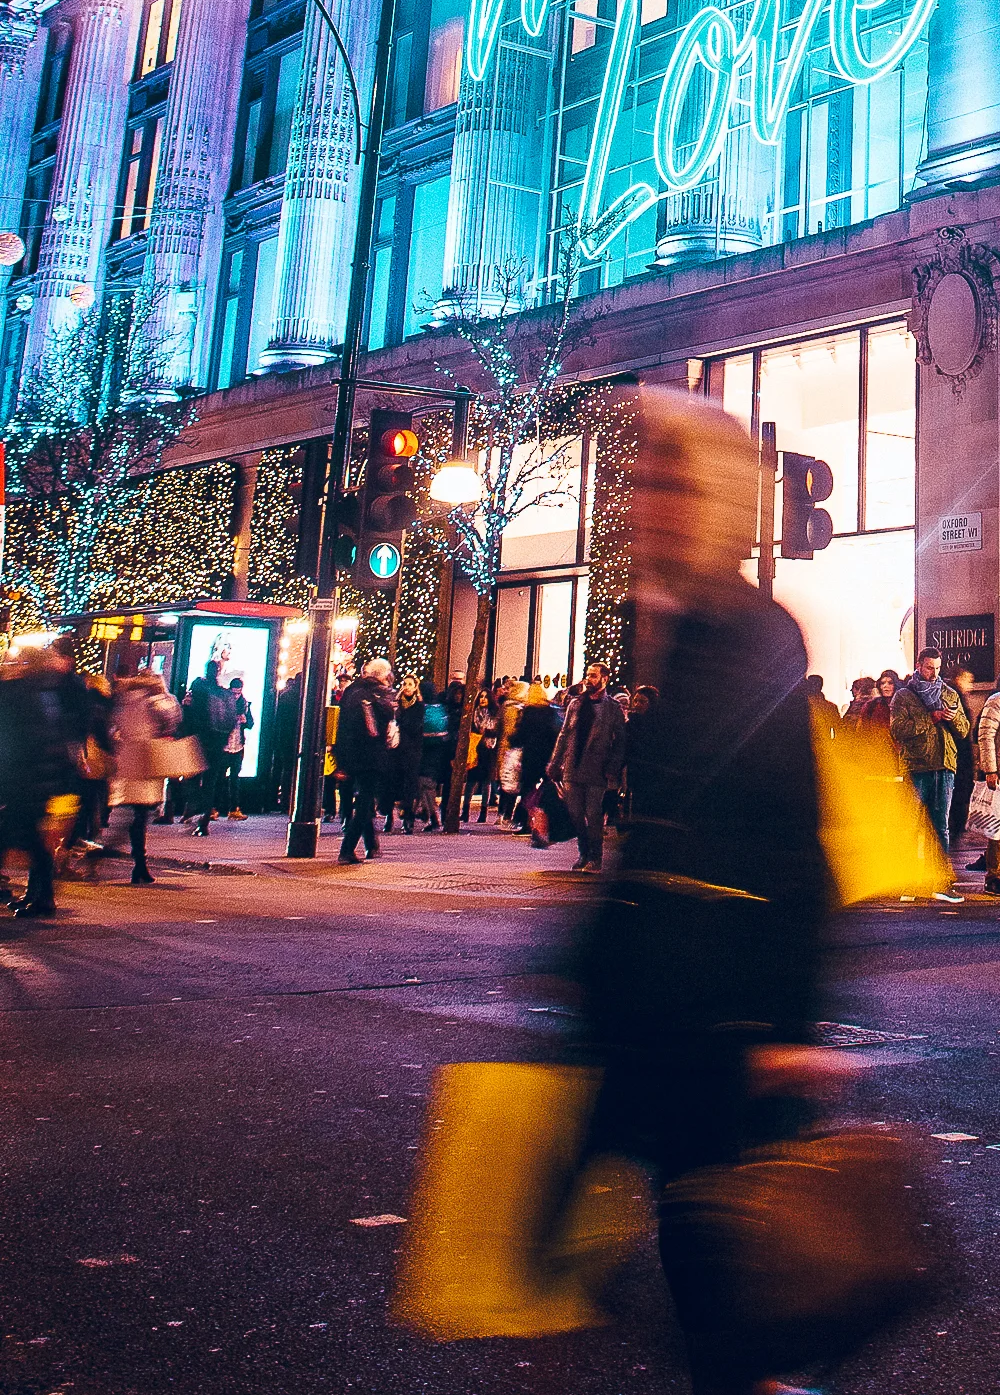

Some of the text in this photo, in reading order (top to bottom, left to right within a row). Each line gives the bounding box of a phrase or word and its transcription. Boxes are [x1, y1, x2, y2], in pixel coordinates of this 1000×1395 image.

[942, 517, 968, 529] OXFORD
[942, 528, 965, 541] STREET
[932, 628, 988, 649] SELFRIDGE
